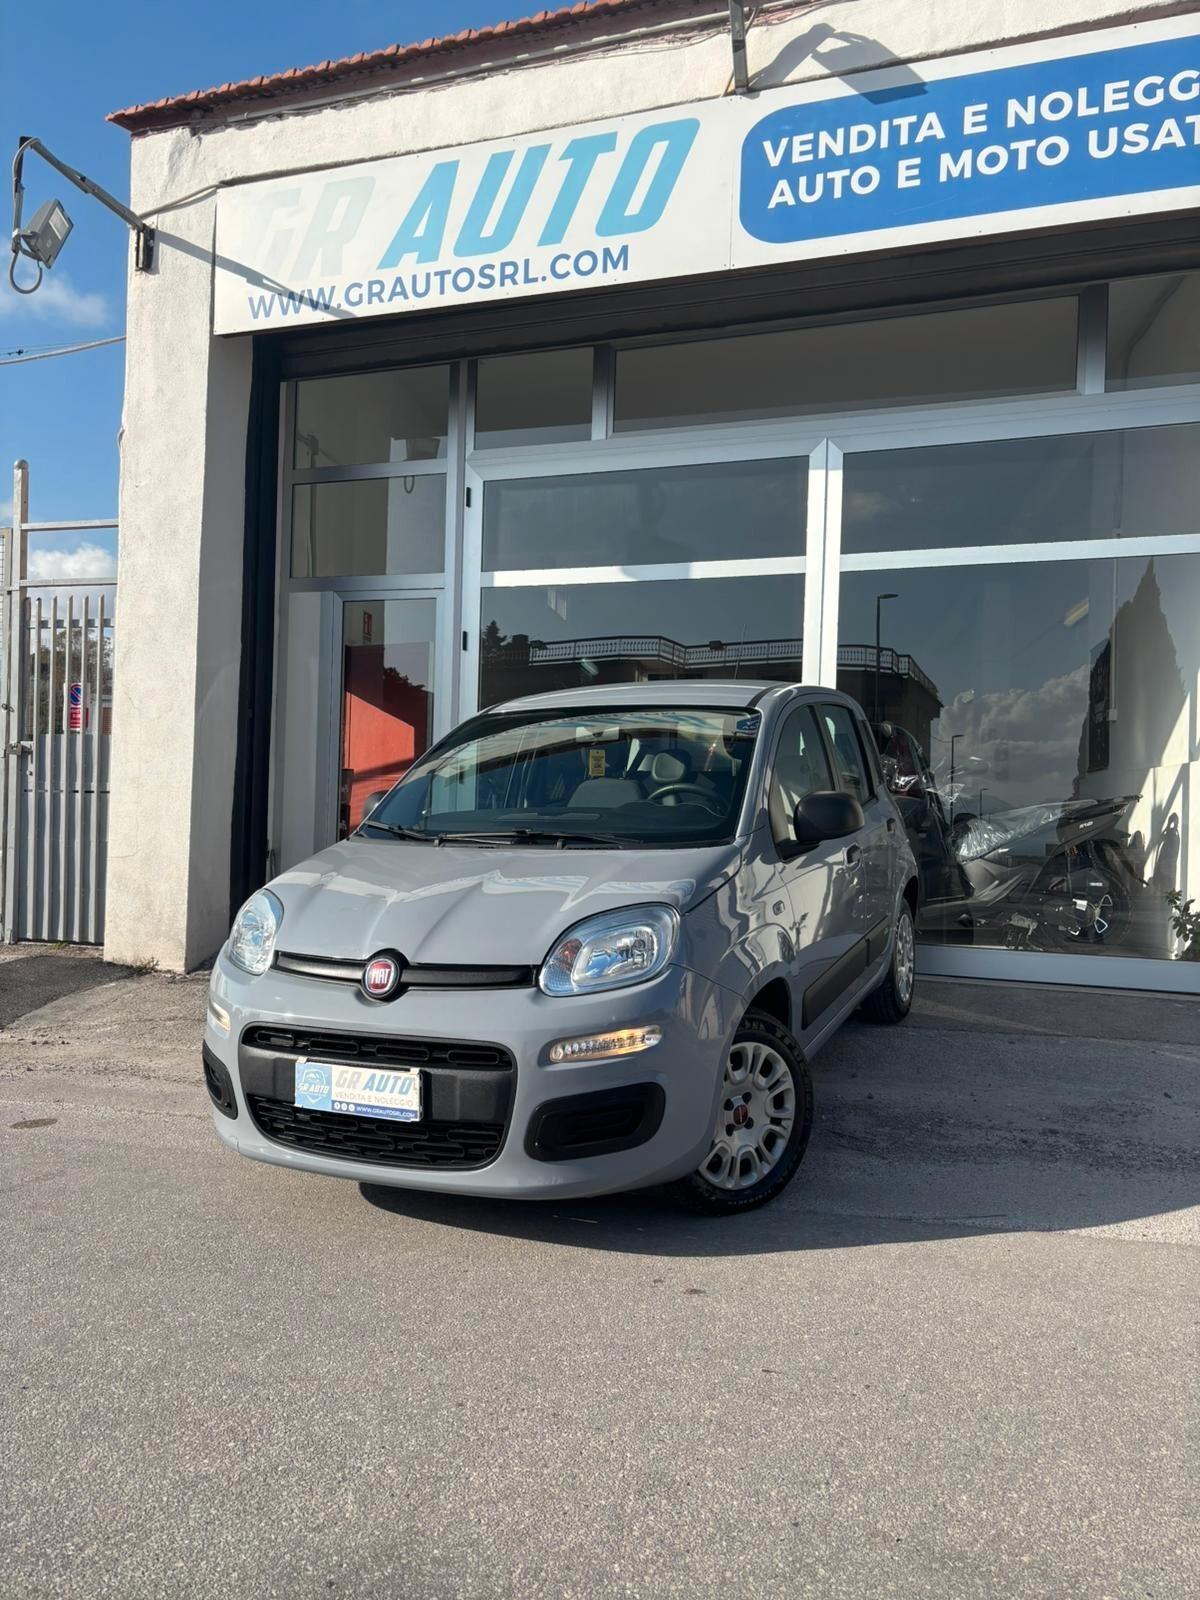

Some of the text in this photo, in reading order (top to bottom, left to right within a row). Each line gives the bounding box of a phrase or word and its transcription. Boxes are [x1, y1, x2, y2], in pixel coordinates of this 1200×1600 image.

[762, 70, 1200, 167] VENDITA E NOLEGG
[376, 117, 700, 270] AUTO
[767, 165, 880, 209] AUTO
[897, 157, 921, 189] E
[939, 136, 1069, 182] MOTO
[248, 245, 629, 320] WWW.GRAUTOSRL.COM
[370, 967, 391, 985] FIAT
[335, 1069, 415, 1095] GR AUTO
[335, 1091, 414, 1107] VENDITA E NOLEGGIO
